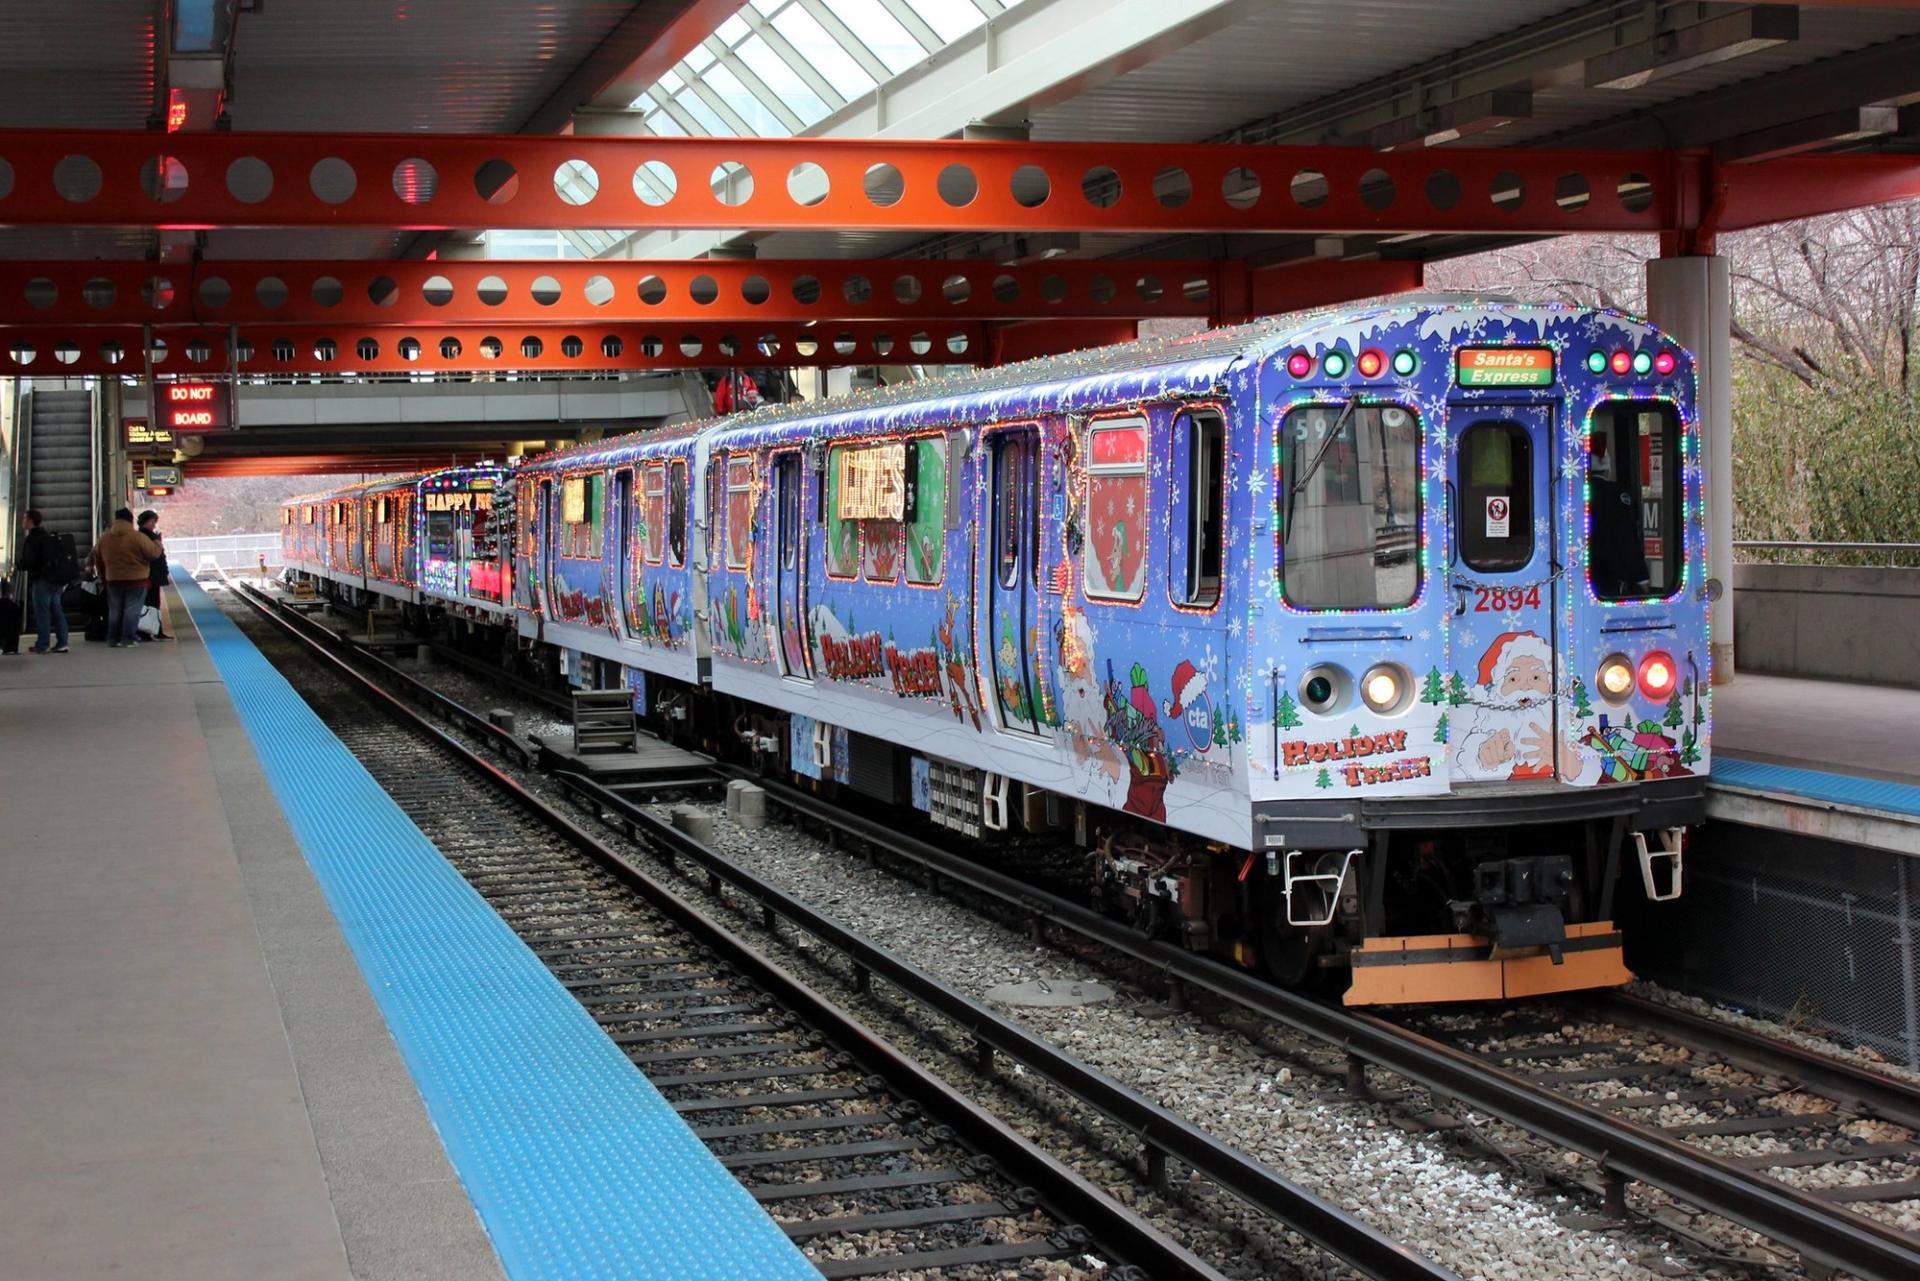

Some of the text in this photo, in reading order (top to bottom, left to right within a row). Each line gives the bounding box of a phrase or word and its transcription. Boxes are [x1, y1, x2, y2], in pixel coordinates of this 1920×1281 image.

[1473, 352, 1536, 367] Santa's
[1470, 369, 1539, 385] Express
[171, 387, 214, 400] DO NOT
[175, 412, 212, 425] BOARD
[425, 492, 472, 512] HAPPY
[1474, 585, 1541, 612] 2894
[1188, 707, 1208, 729] cta
[1280, 729, 1408, 766] HOLIDAY
[1339, 755, 1431, 787] TRAIN
